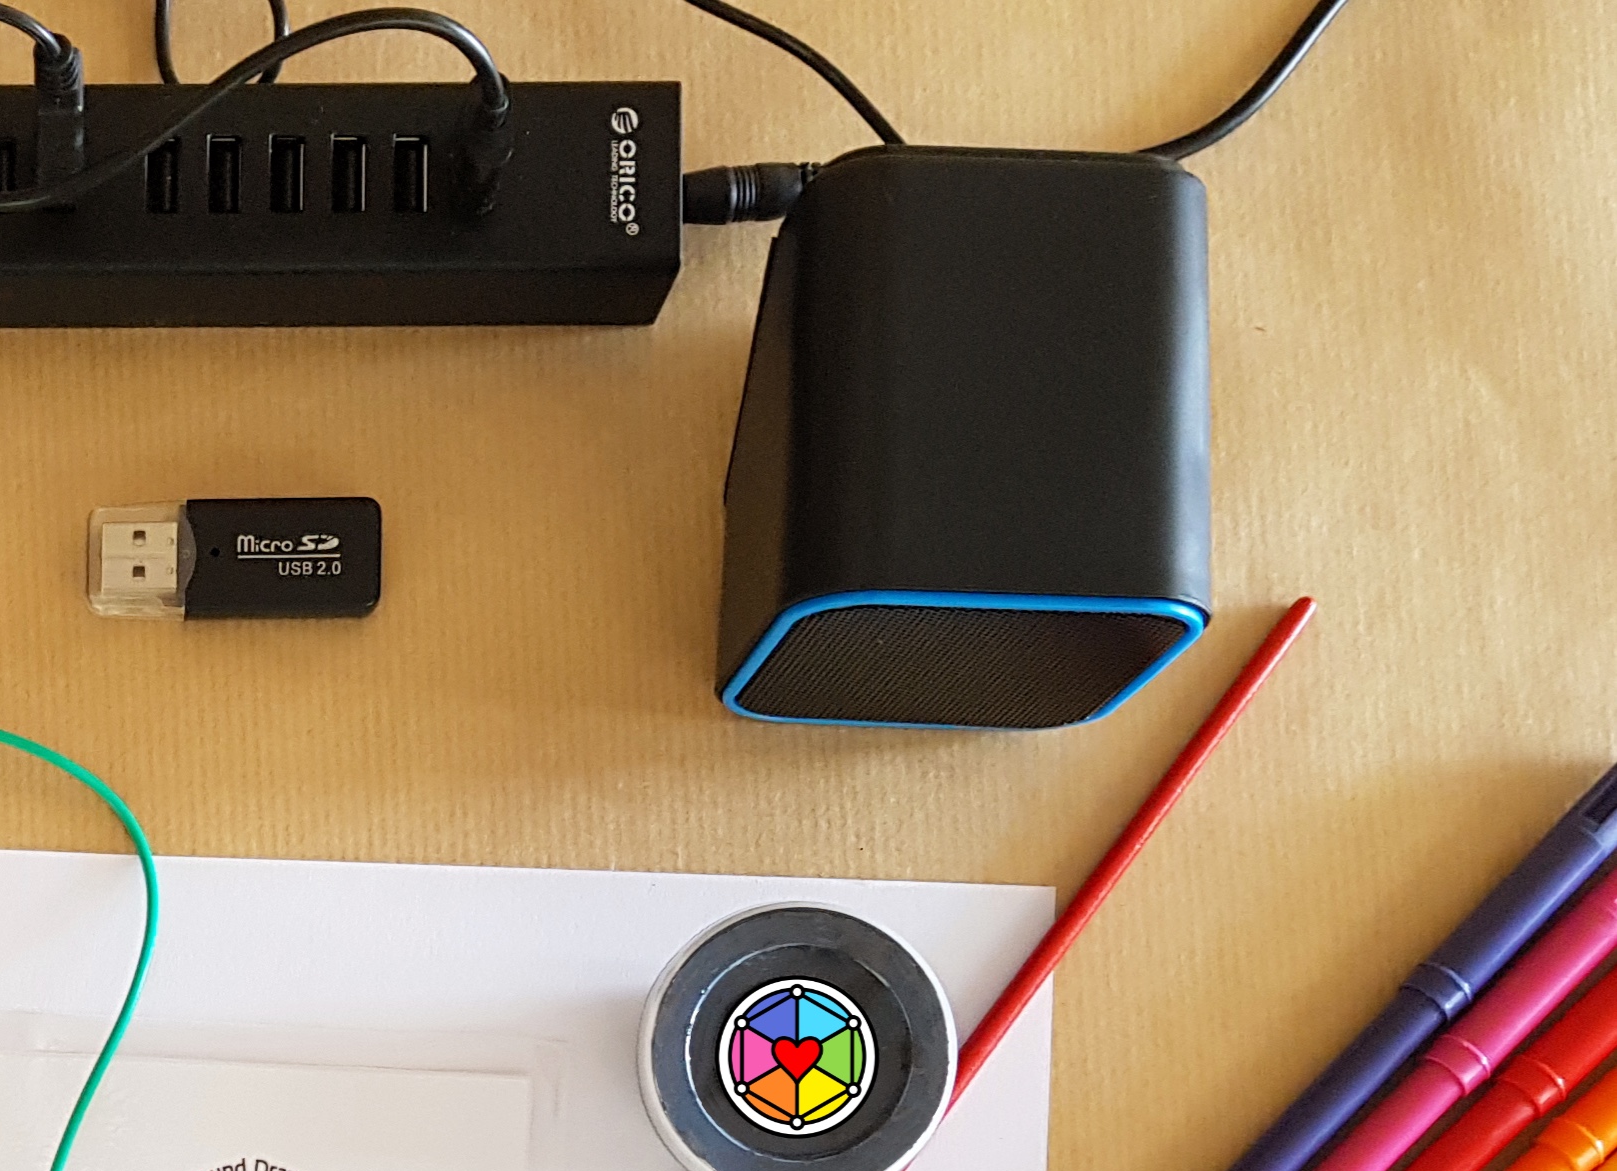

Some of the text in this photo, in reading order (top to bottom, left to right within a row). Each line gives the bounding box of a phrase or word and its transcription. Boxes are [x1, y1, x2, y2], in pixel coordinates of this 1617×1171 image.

[618, 139, 636, 222] ORICO
[237, 534, 293, 553] Micro
[278, 561, 342, 576] USB 2.0
